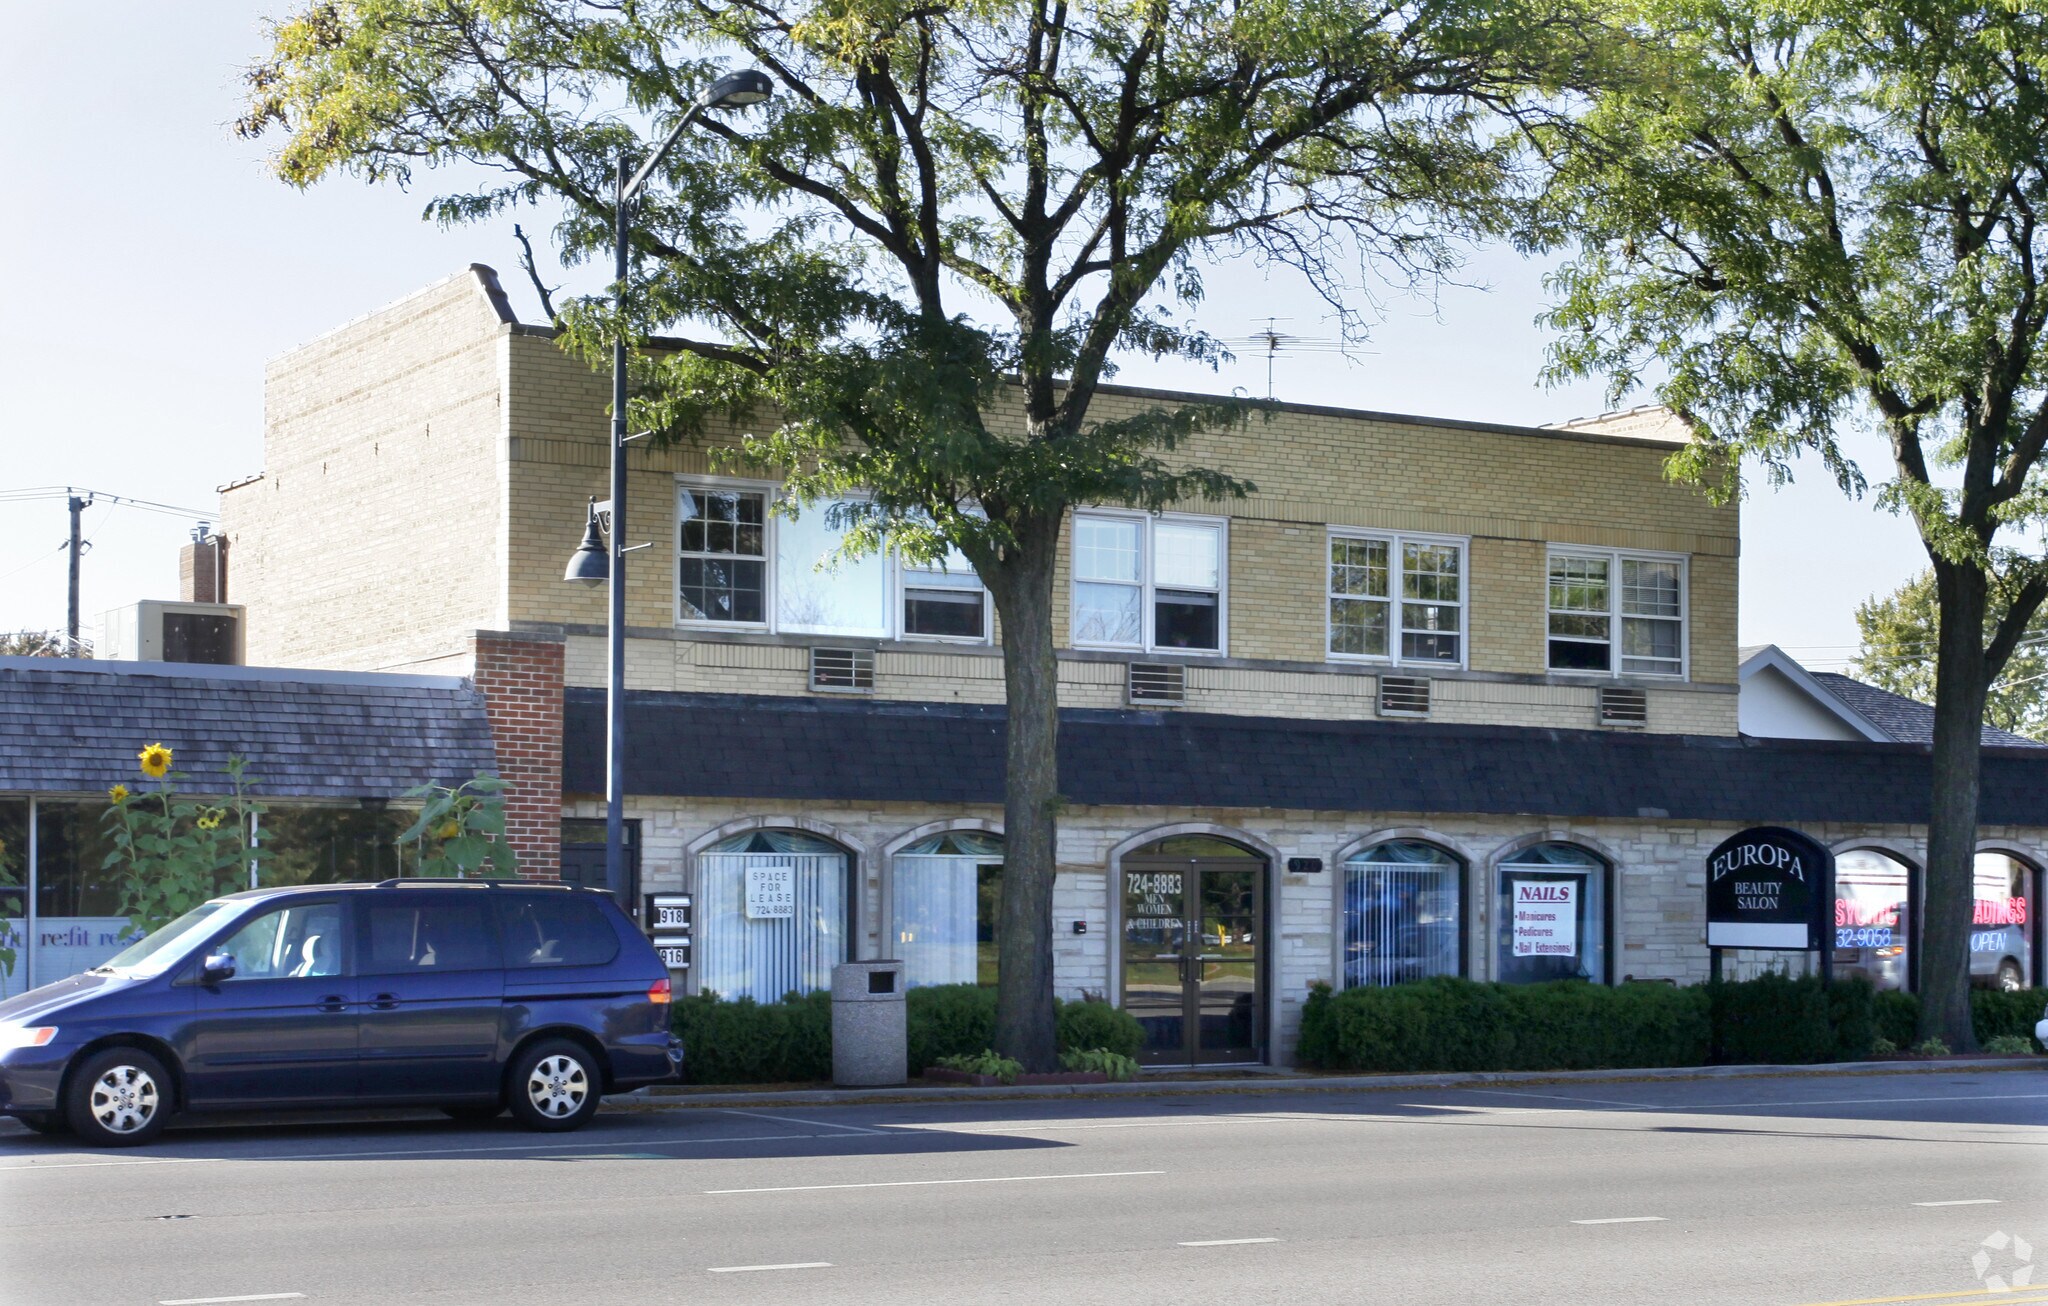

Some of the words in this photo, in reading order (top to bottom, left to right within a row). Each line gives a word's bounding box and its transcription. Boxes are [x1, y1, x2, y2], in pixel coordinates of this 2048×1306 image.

[1712, 844, 1805, 882] EUROPA
[752, 872, 787, 881] SPACE
[760, 883, 781, 891] FOR
[1127, 873, 1182, 894] 724-8883
[1735, 882, 1782, 895] BEAUTY
[750, 893, 791, 902] LEASE
[1145, 893, 1165, 904] MEN
[1519, 886, 1570, 901] NAILS
[1737, 896, 1778, 909] SALON
[1137, 904, 1172, 915] WOMEN
[661, 910, 683, 923] 918
[1519, 911, 1556, 921] Manicures
[1519, 926, 1553, 936] Pedicures
[1519, 942, 1531, 953] Nail
[1971, 932, 2007, 951] OPEN
[661, 950, 682, 963] 916
